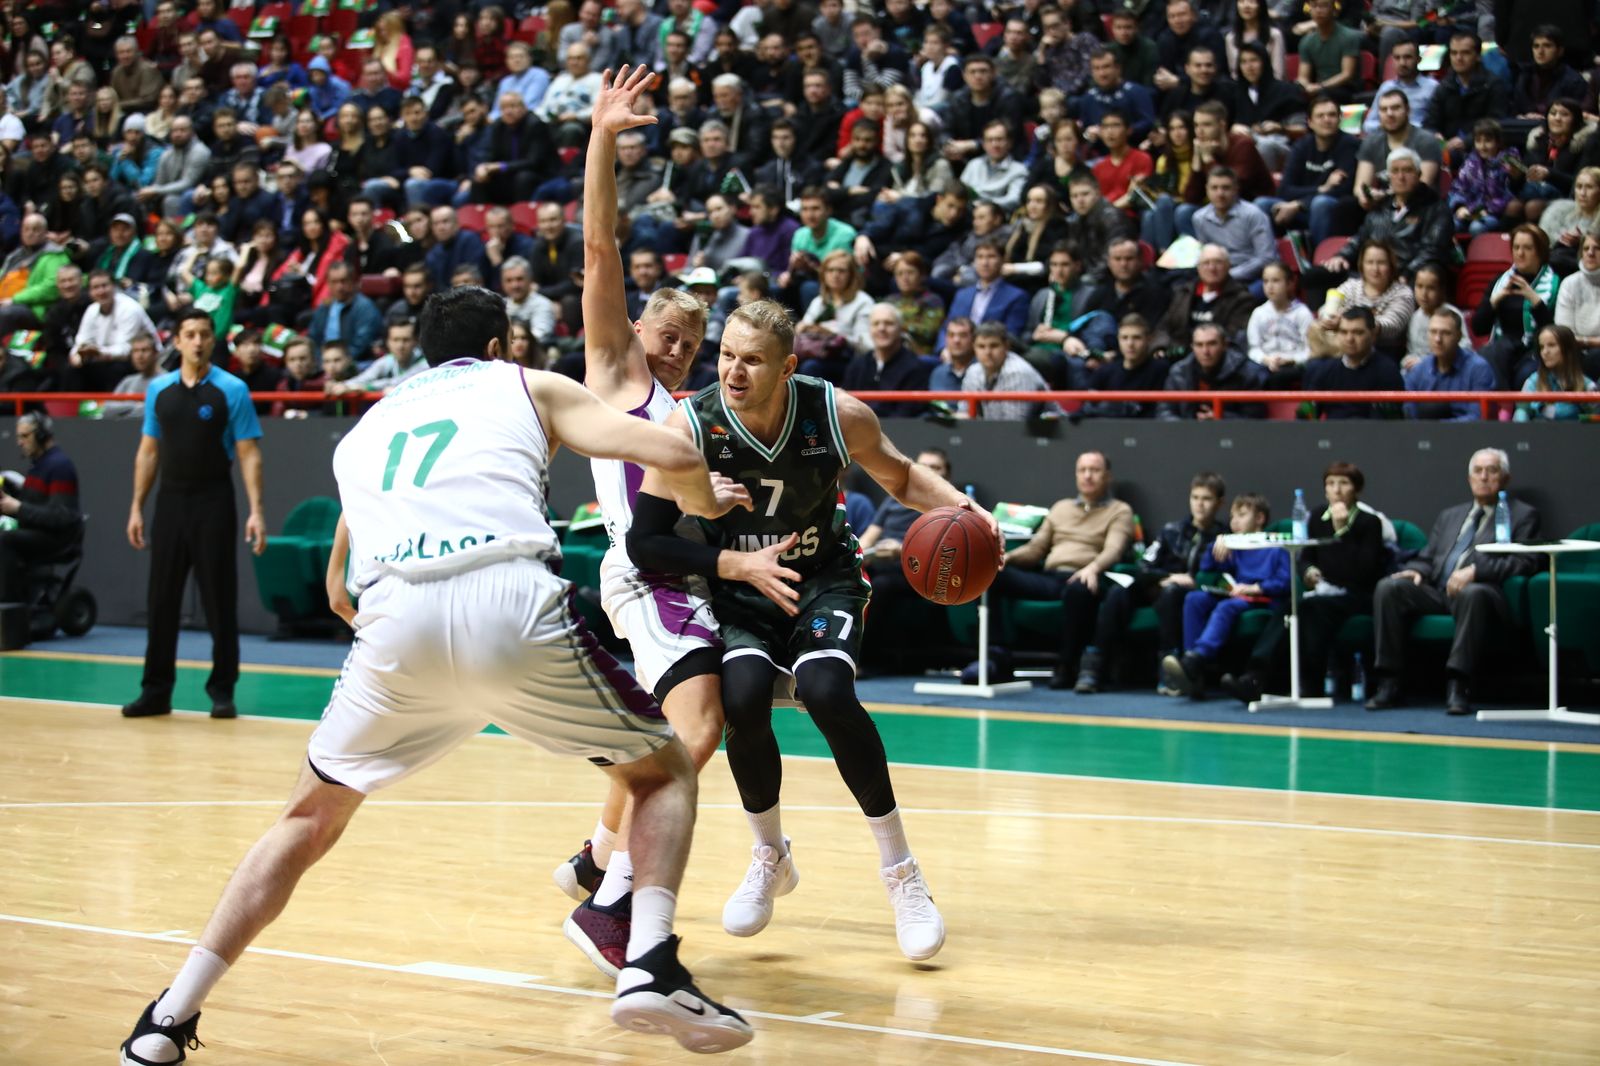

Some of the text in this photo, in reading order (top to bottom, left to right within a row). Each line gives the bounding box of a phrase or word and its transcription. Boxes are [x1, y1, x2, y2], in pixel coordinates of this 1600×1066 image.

[382, 419, 459, 492] 17
[760, 478, 785, 518] 7
[833, 609, 854, 641] 7
